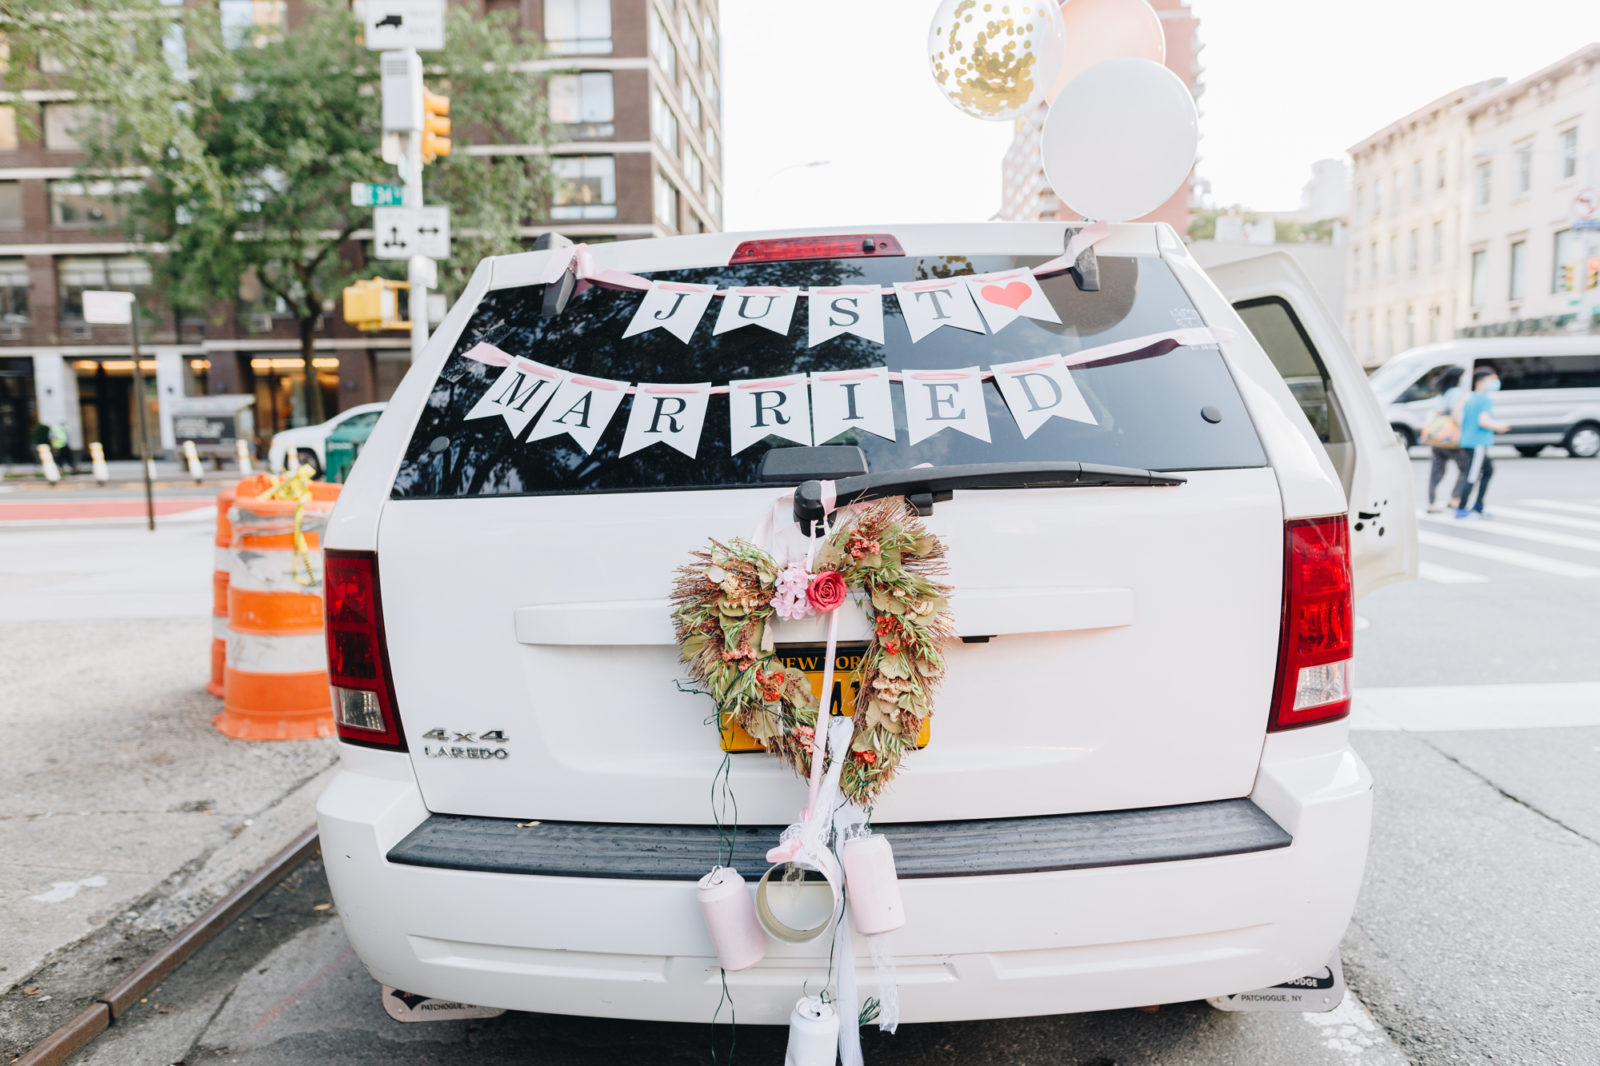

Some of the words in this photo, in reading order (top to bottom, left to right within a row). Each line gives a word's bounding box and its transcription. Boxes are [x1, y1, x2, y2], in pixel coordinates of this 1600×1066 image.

[653, 288, 954, 328] JUST
[491, 371, 1064, 433] MARRIED
[424, 745, 508, 760] LAREDO
[1241, 994, 1289, 1002] PATCHOGUE,
[1291, 994, 1303, 1002] NY
